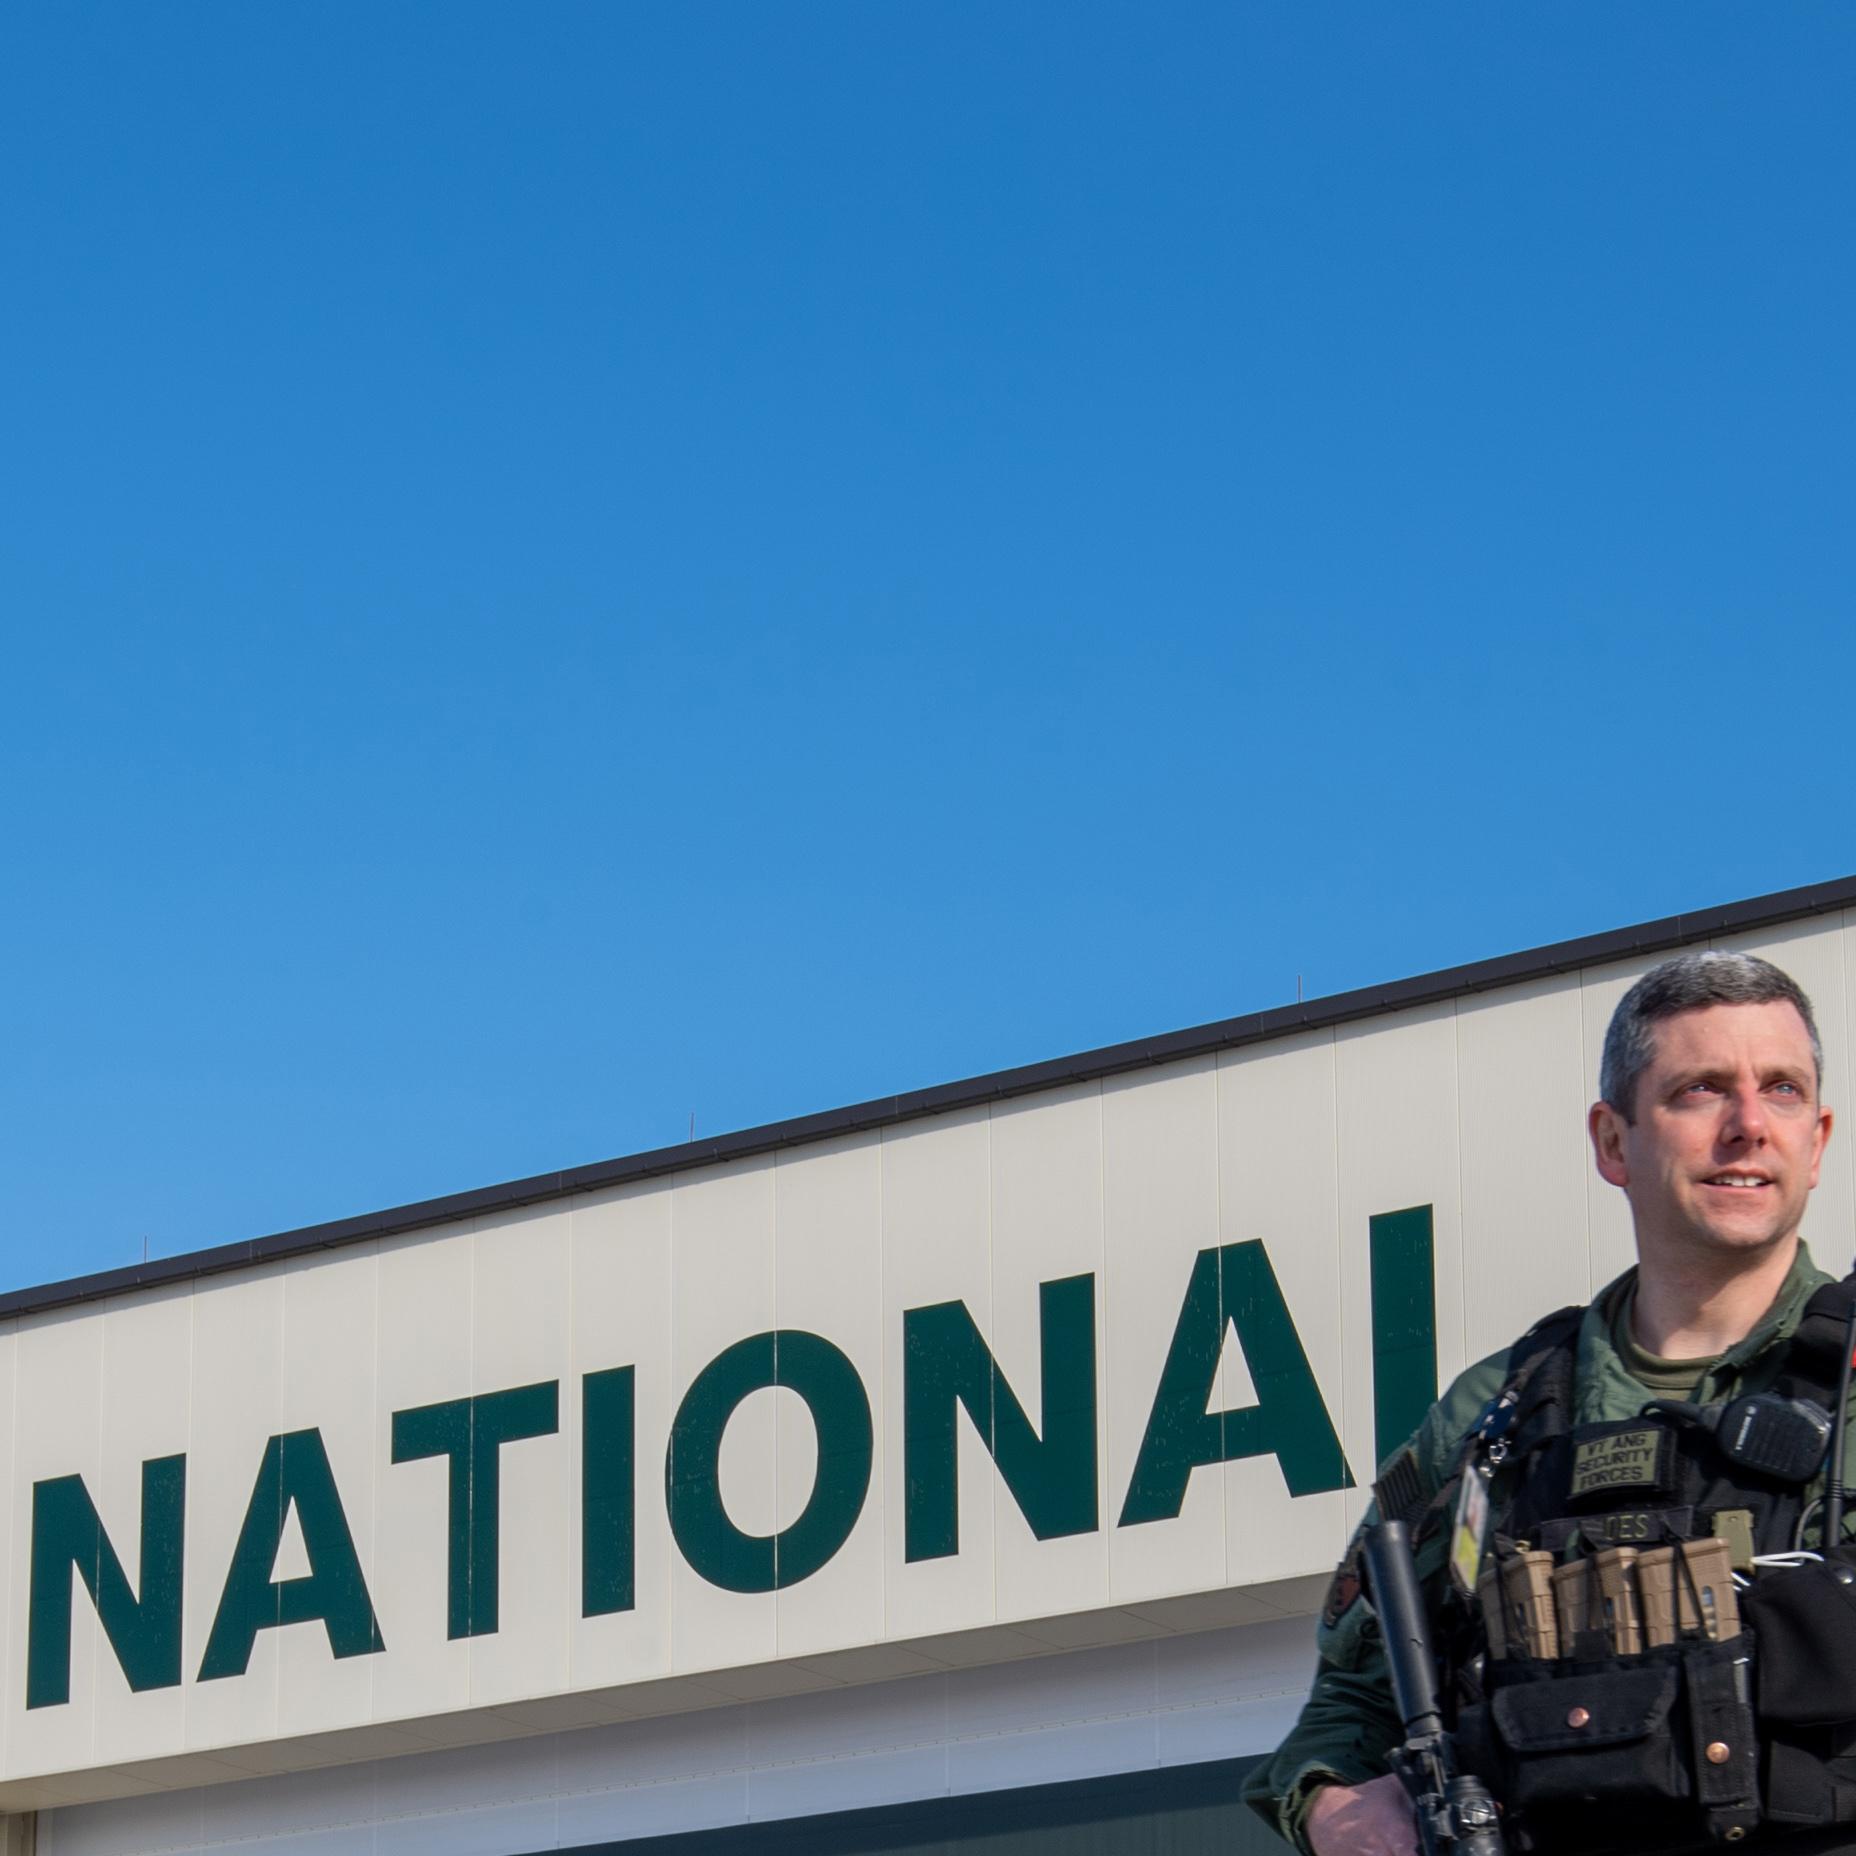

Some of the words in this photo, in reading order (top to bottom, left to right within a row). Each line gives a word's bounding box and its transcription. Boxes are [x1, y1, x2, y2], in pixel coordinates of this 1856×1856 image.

[1587, 1440, 1607, 1456] VT
[1611, 1433, 1647, 1449] ANG
[1576, 1448, 1653, 1475] SECURITY
[1580, 1466, 1643, 1489] FORCES
